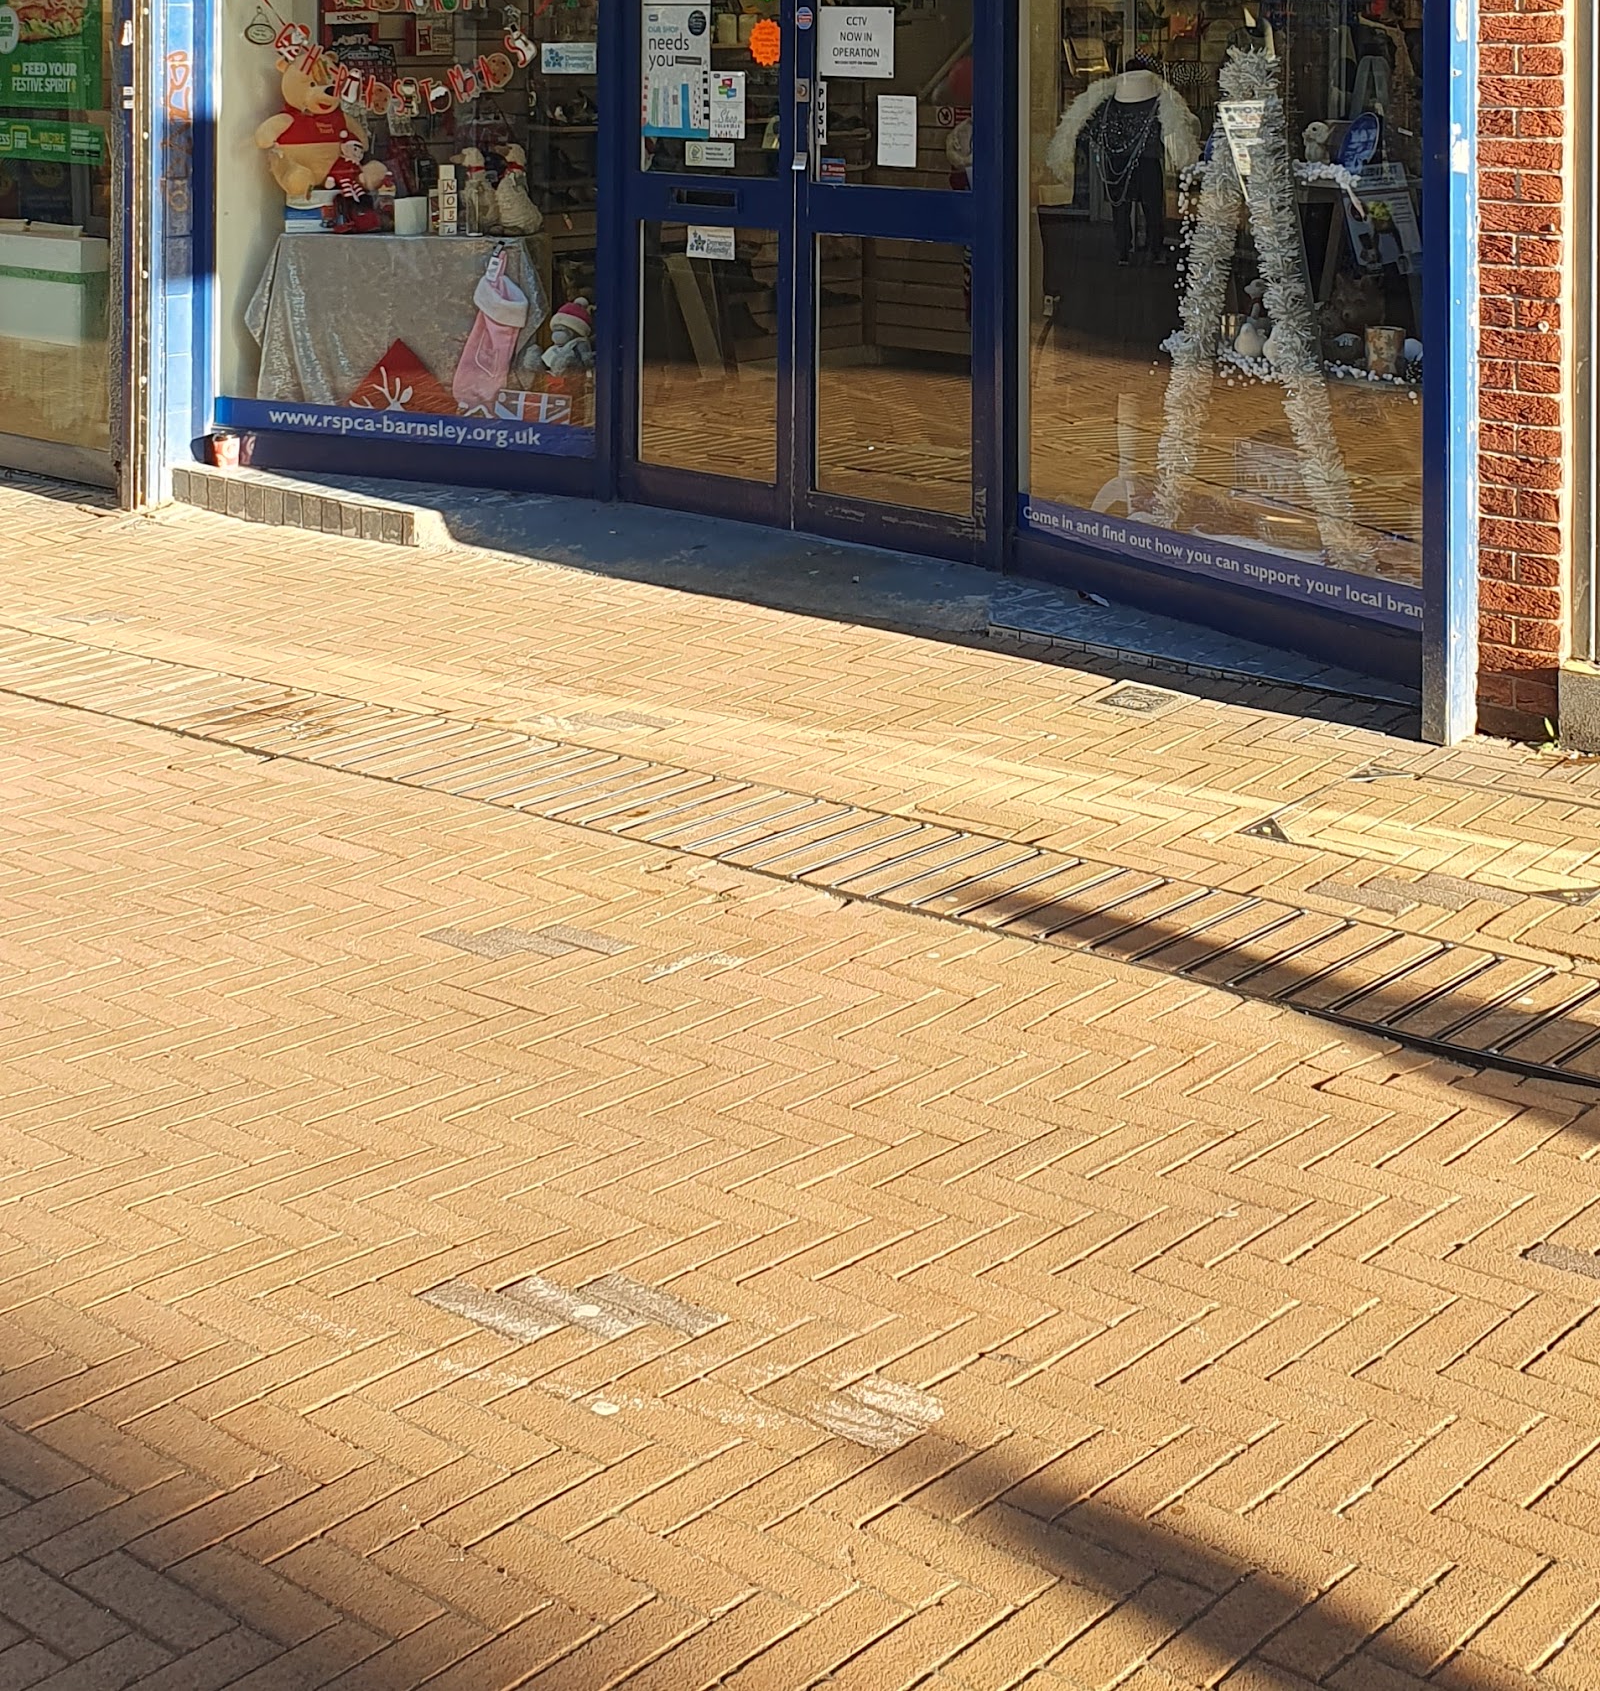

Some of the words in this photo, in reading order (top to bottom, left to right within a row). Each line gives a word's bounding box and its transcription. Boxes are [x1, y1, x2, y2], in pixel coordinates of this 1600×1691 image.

[846, 16, 867, 27] CCTV
[648, 32, 689, 51] needs
[840, 31, 862, 42] NOW
[864, 31, 873, 42] IN
[832, 47, 880, 58] OPERATION
[22, 62, 47, 76] FEED
[49, 62, 77, 76] YOUR
[648, 54, 674, 71] you
[12, 77, 45, 92] FESTIVE
[45, 78, 71, 93] SPIRIT
[817, 88, 825, 139] PUSH
[269, 409, 541, 448] www.rspca-barnsley.org.uk
[1022, 506, 1059, 527] Come
[1062, 514, 1074, 531] in
[1076, 521, 1099, 537] and
[1102, 525, 1126, 543] find
[1129, 534, 1152, 550] out
[1155, 538, 1183, 558] how
[1187, 548, 1212, 565] you
[1215, 558, 1240, 572] can
[1243, 562, 1301, 587] support
[1306, 578, 1342, 597] your
[1345, 585, 1383, 608] local
